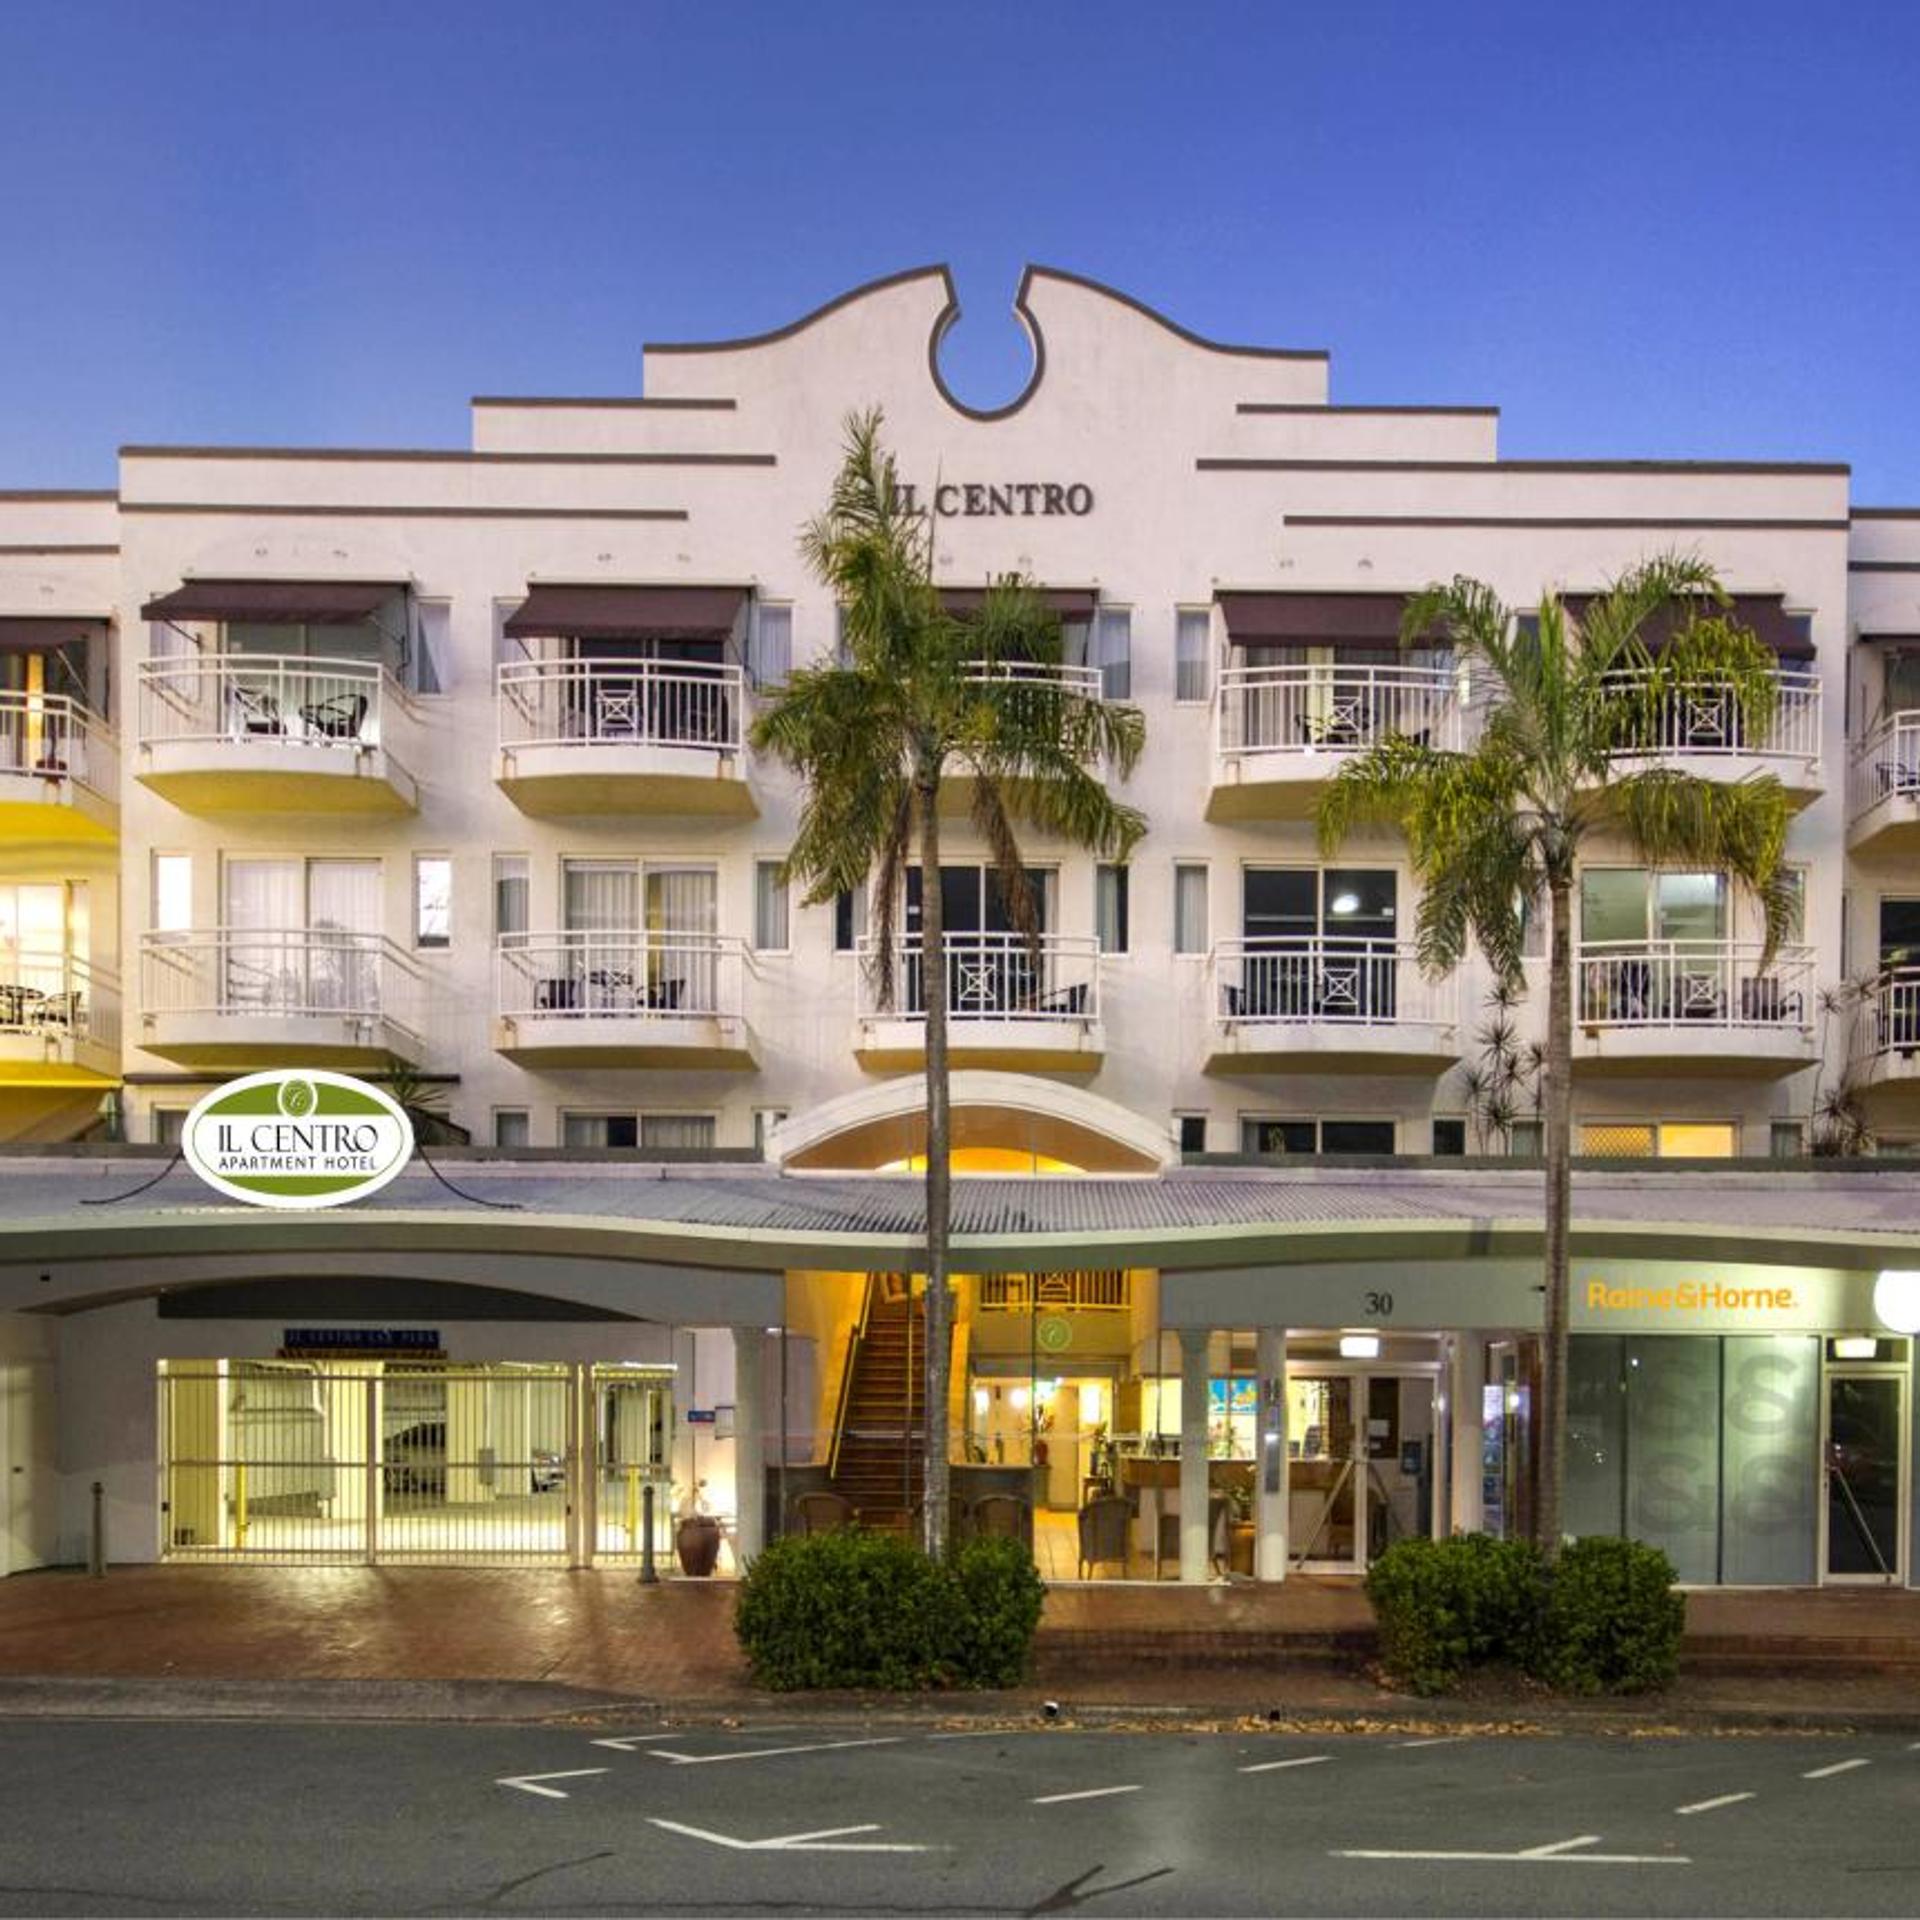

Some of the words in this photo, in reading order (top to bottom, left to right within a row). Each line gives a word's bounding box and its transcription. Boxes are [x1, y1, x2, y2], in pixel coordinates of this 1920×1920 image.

[936, 483, 1094, 517] CENTRO
[218, 1124, 242, 1153] IL
[250, 1123, 379, 1154] CENTRO
[219, 1155, 317, 1170] APARTMENT
[324, 1155, 377, 1170] HOTEL
[1364, 1292, 1394, 1316] 30
